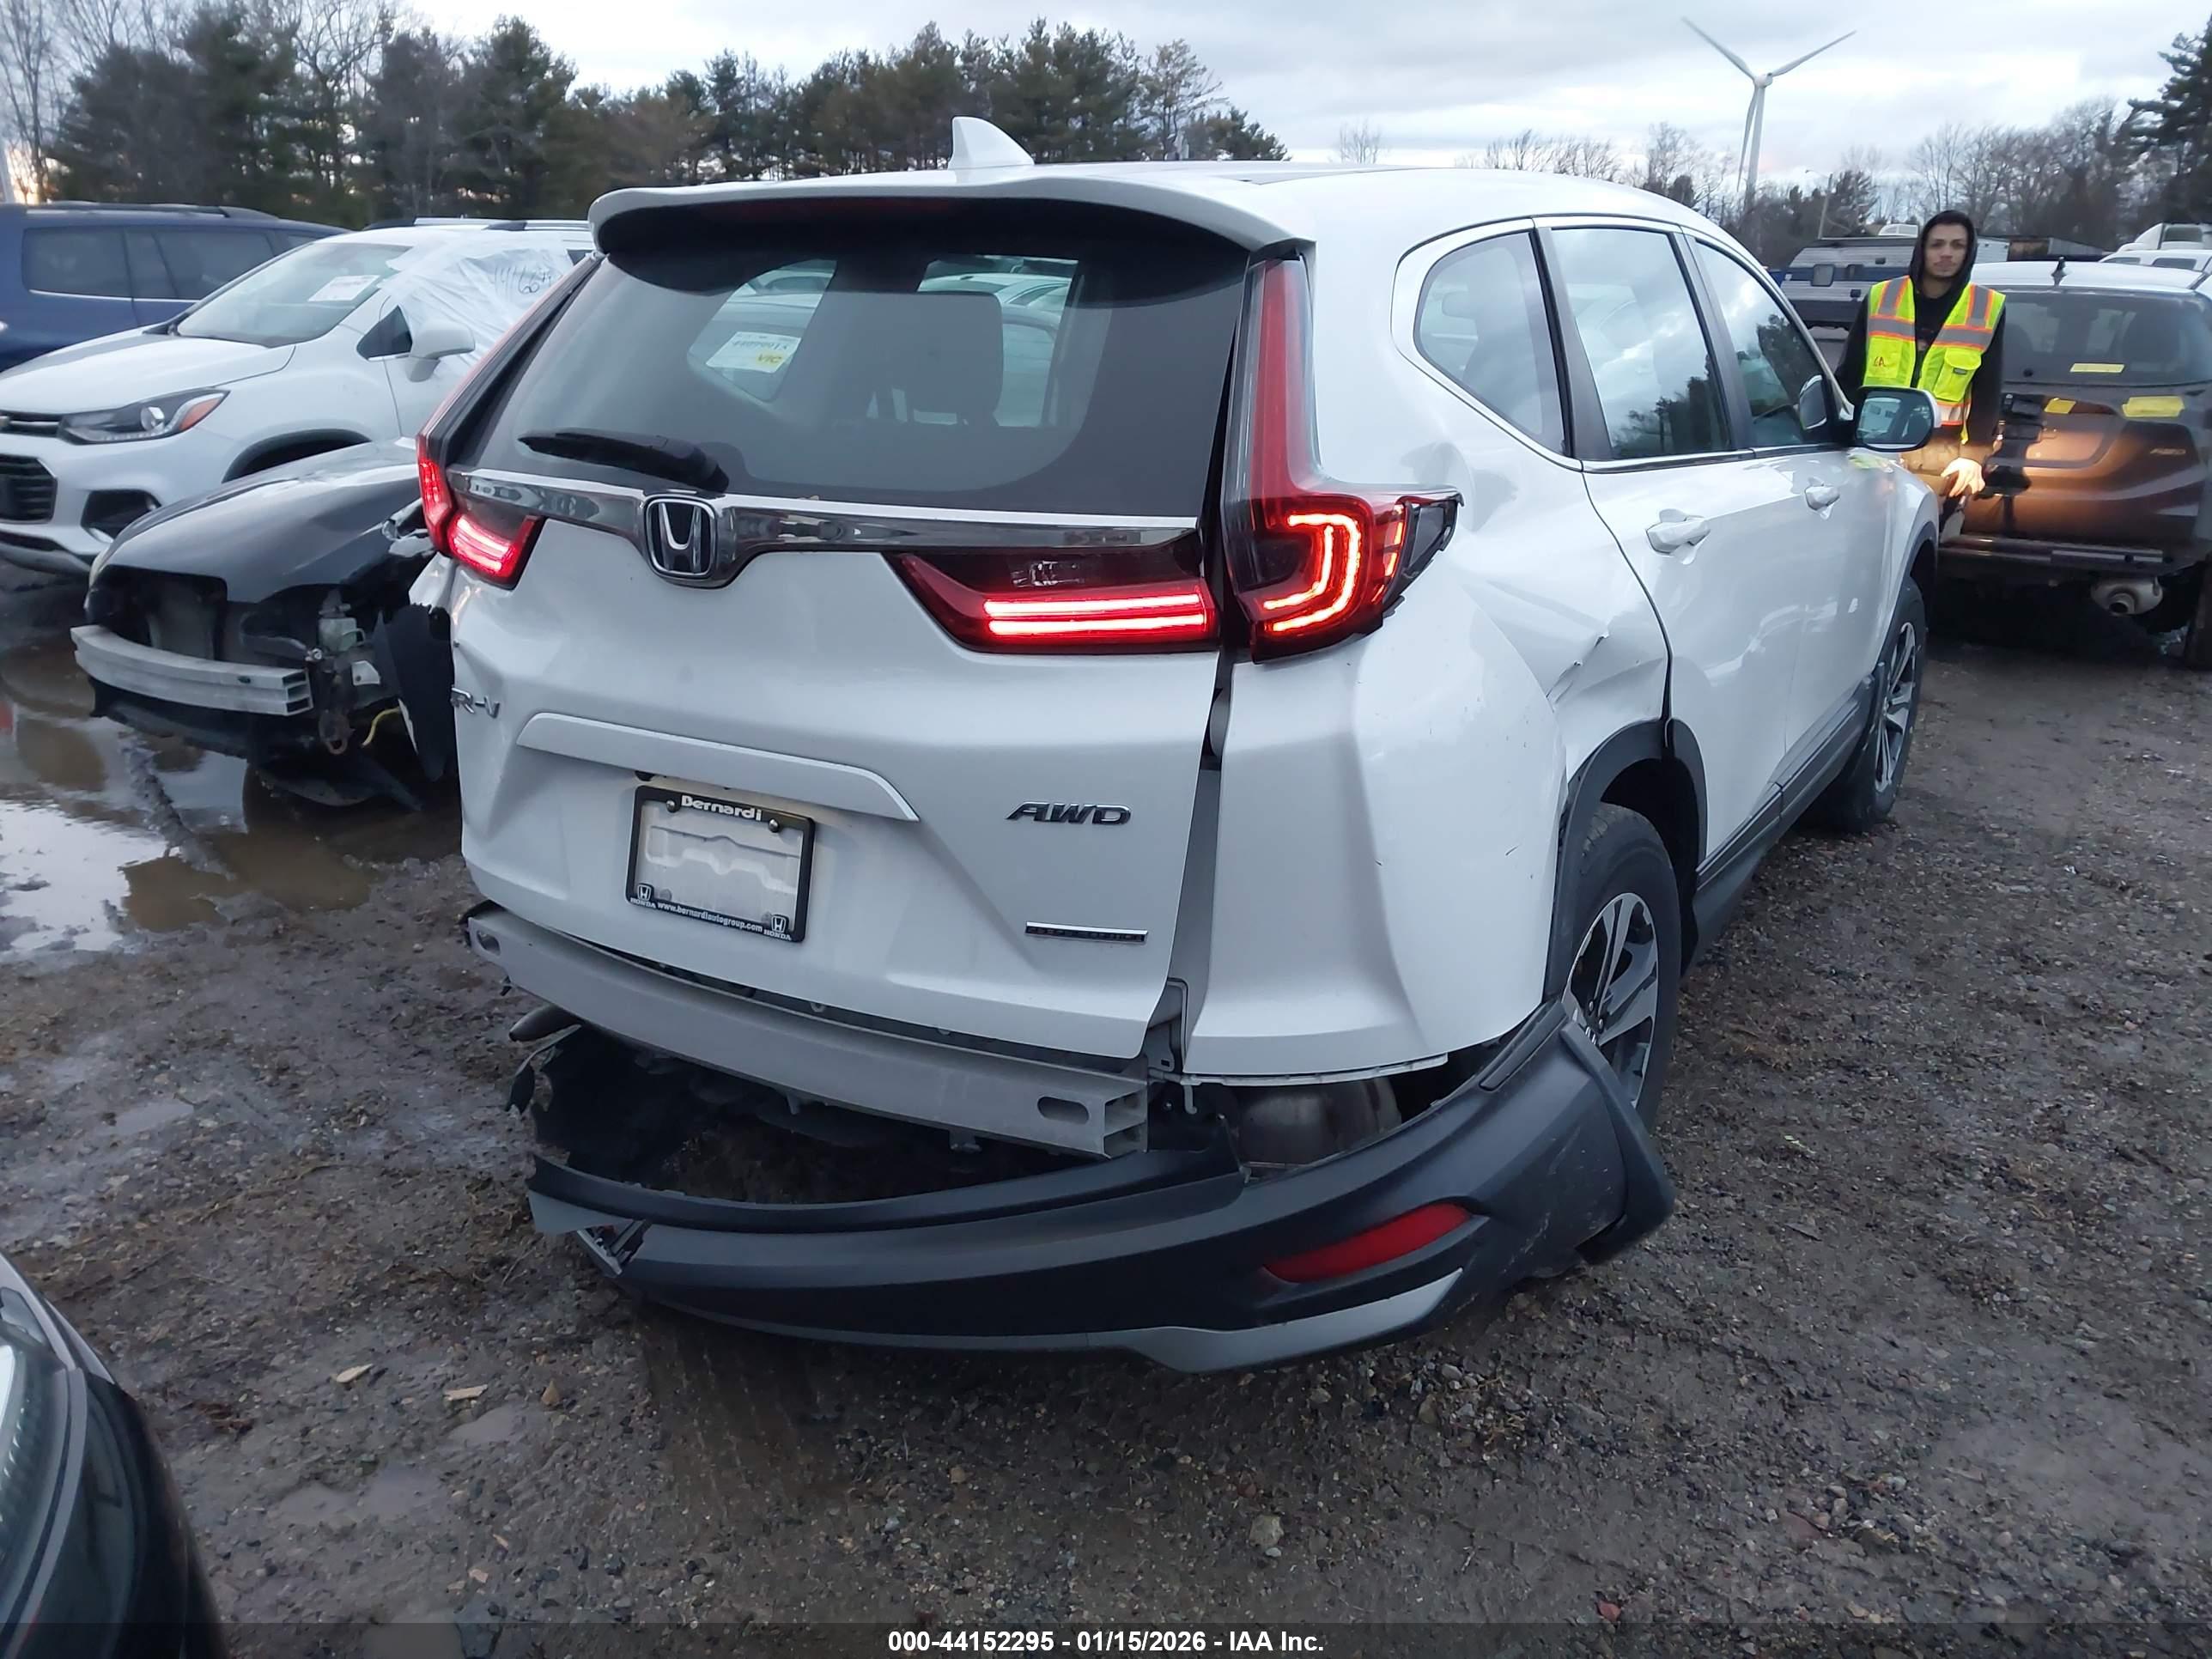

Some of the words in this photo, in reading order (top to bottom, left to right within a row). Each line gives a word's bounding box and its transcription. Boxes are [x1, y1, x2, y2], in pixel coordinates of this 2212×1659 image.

[681, 795, 763, 822] Bernardi
[1005, 801, 1132, 825] AWD
[630, 897, 657, 909] HONDA
[658, 902, 763, 933] www.bernardiautogroup.com
[763, 928, 793, 941] HONDA
